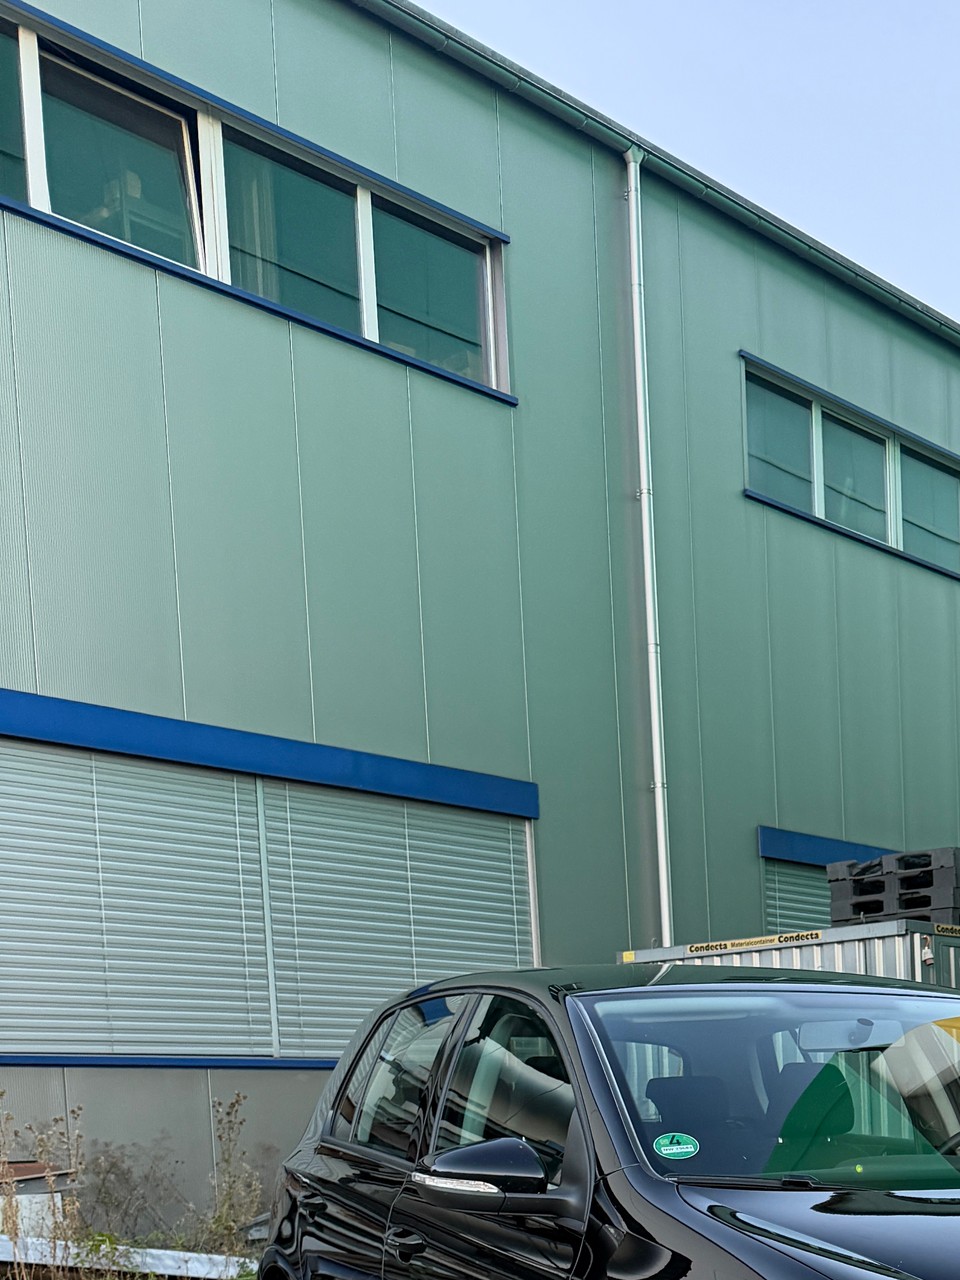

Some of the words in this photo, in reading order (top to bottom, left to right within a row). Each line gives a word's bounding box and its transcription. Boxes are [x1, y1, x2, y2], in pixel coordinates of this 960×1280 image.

[689, 943, 728, 953] Condecta
[778, 932, 820, 943] Condecta
[669, 1135, 682, 1146] 4
